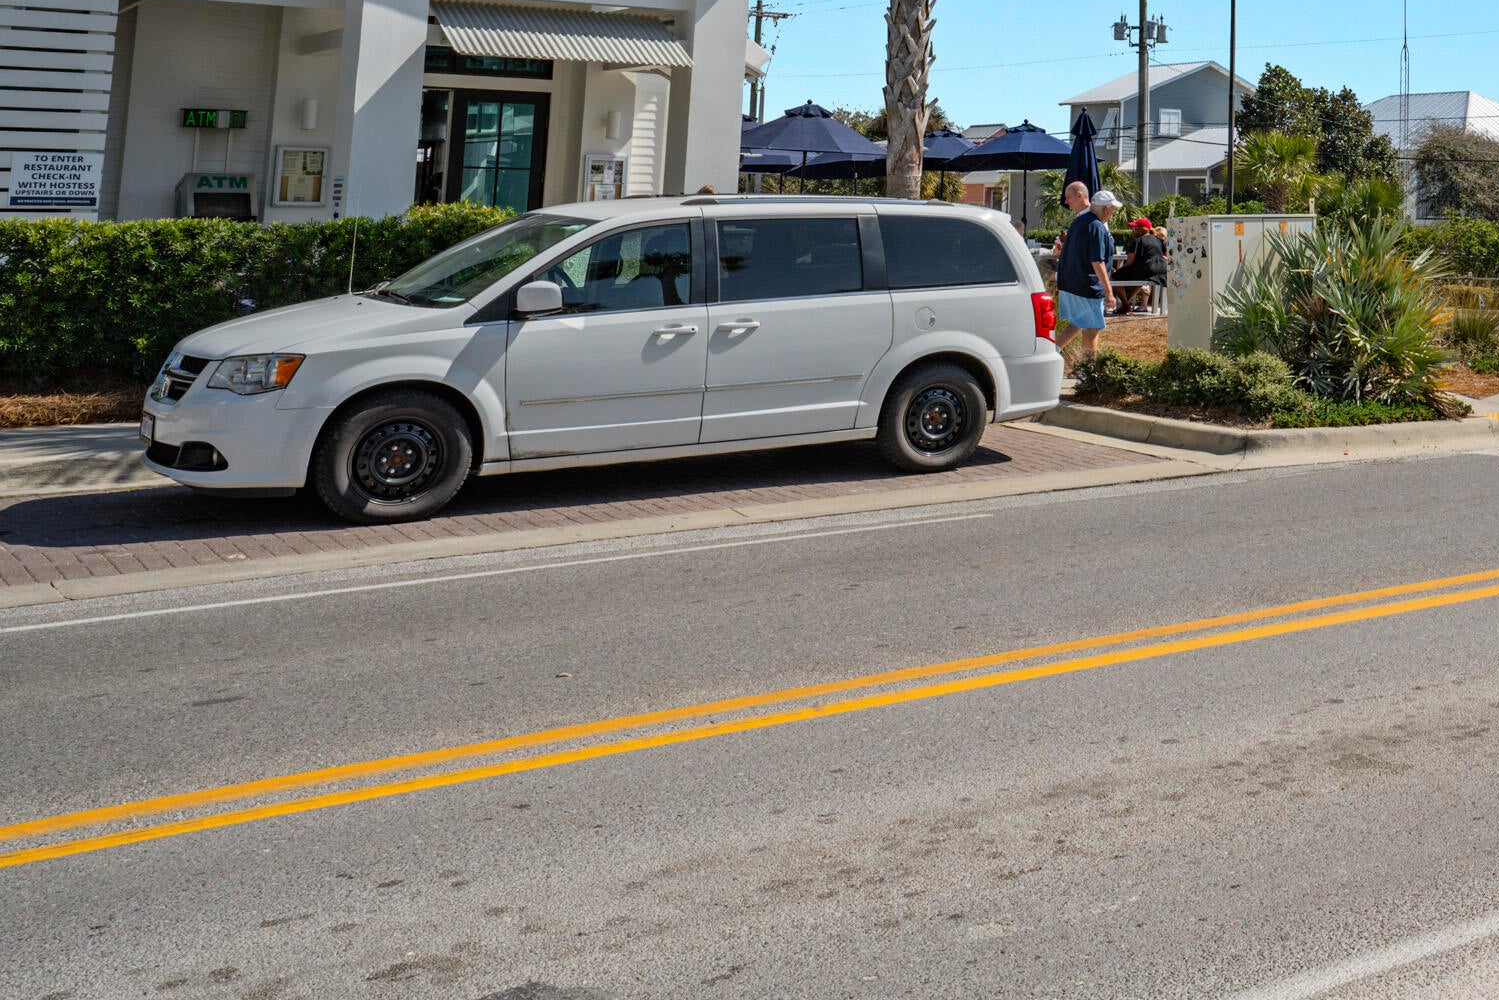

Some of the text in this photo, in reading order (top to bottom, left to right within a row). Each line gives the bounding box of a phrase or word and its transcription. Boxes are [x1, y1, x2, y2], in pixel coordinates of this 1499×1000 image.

[186, 111, 217, 127] ATM
[51, 155, 84, 163] ENTER
[23, 163, 92, 172] RESTAURANT
[18, 181, 95, 190] WITH HOSTESS
[197, 176, 248, 189] ATM
